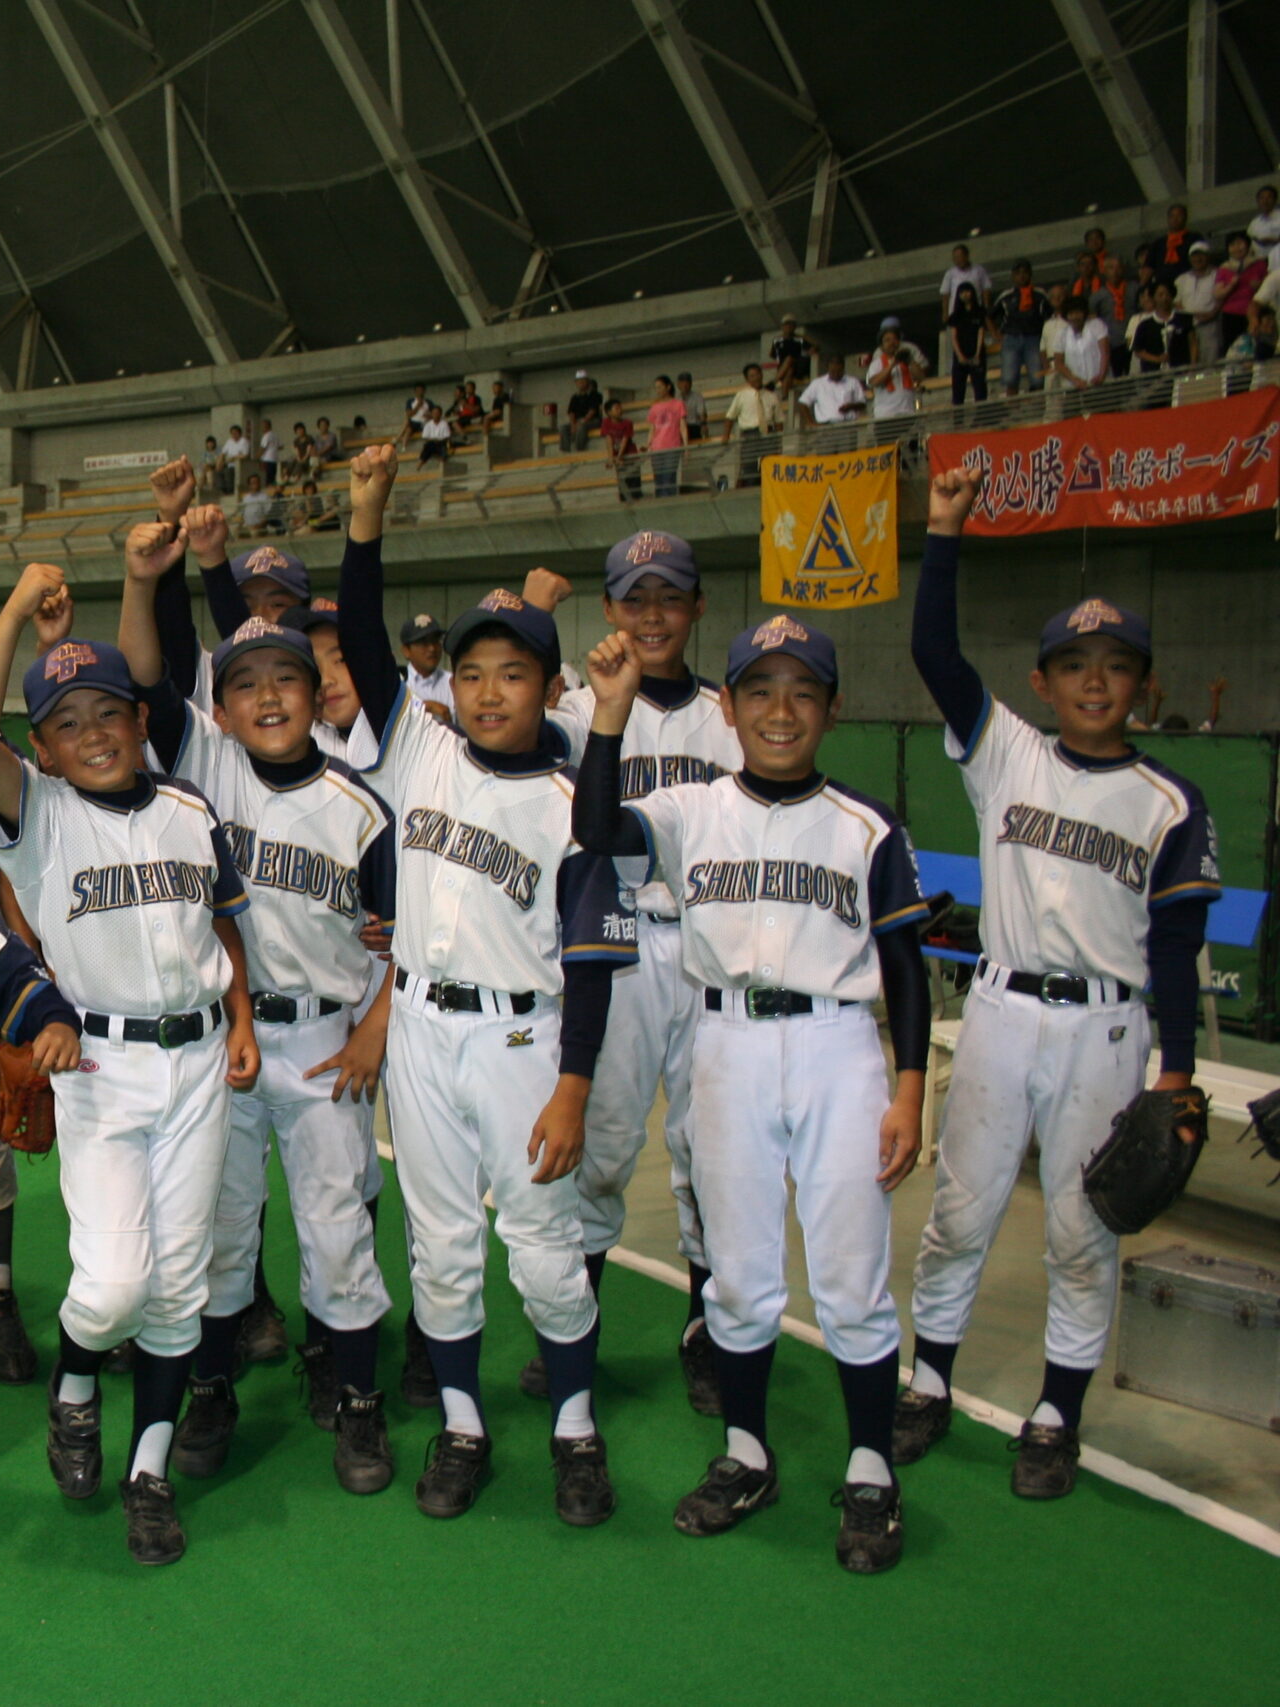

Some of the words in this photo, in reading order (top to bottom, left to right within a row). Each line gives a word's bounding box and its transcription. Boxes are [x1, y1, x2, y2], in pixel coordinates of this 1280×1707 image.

[1107, 421, 1279, 491] 真栄ボーイズ
[602, 911, 636, 941] 清田
[685, 858, 861, 929] SHINEIBOYS
